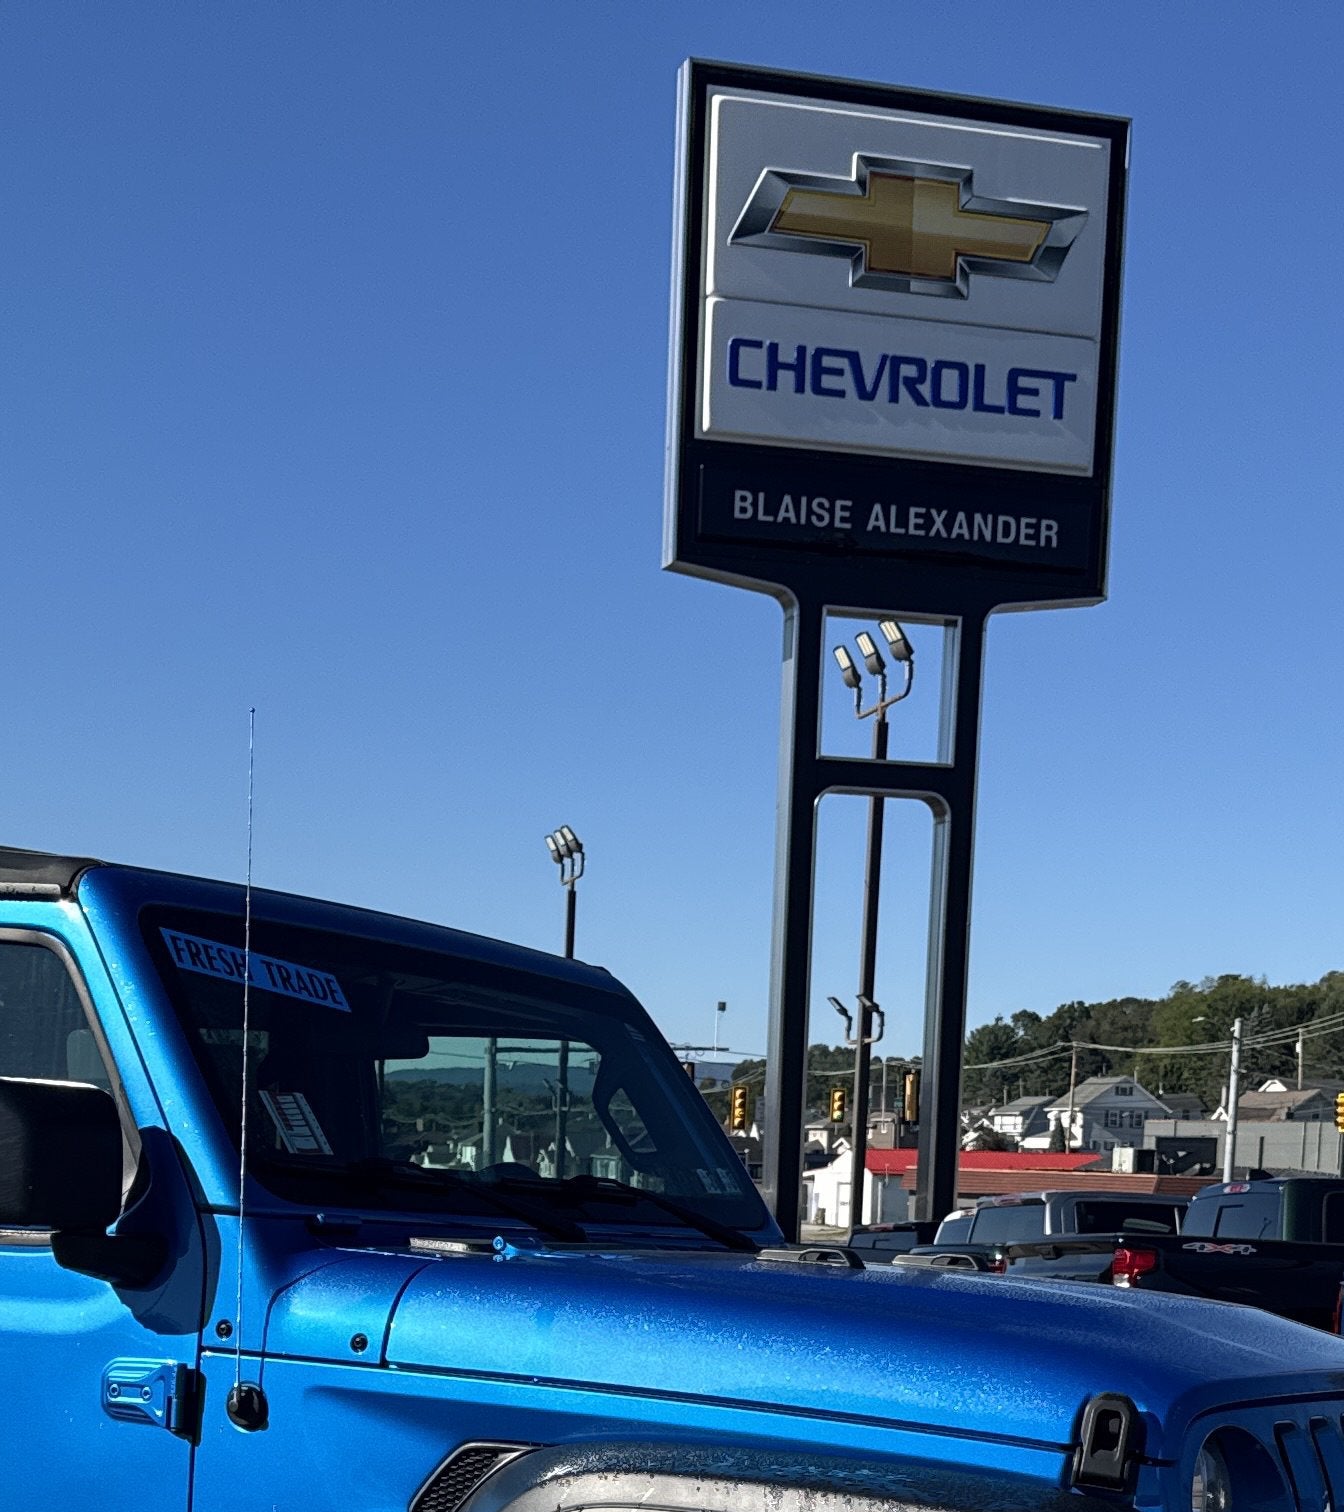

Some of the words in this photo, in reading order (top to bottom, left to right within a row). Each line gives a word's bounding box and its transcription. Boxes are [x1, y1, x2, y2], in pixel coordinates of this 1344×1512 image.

[727, 336, 1077, 421] CHEVROLET
[733, 489, 852, 529] BLAISE
[866, 503, 1058, 548] ALEXANDER
[169, 935, 254, 982] FRESH
[260, 960, 343, 1006] TRADE
